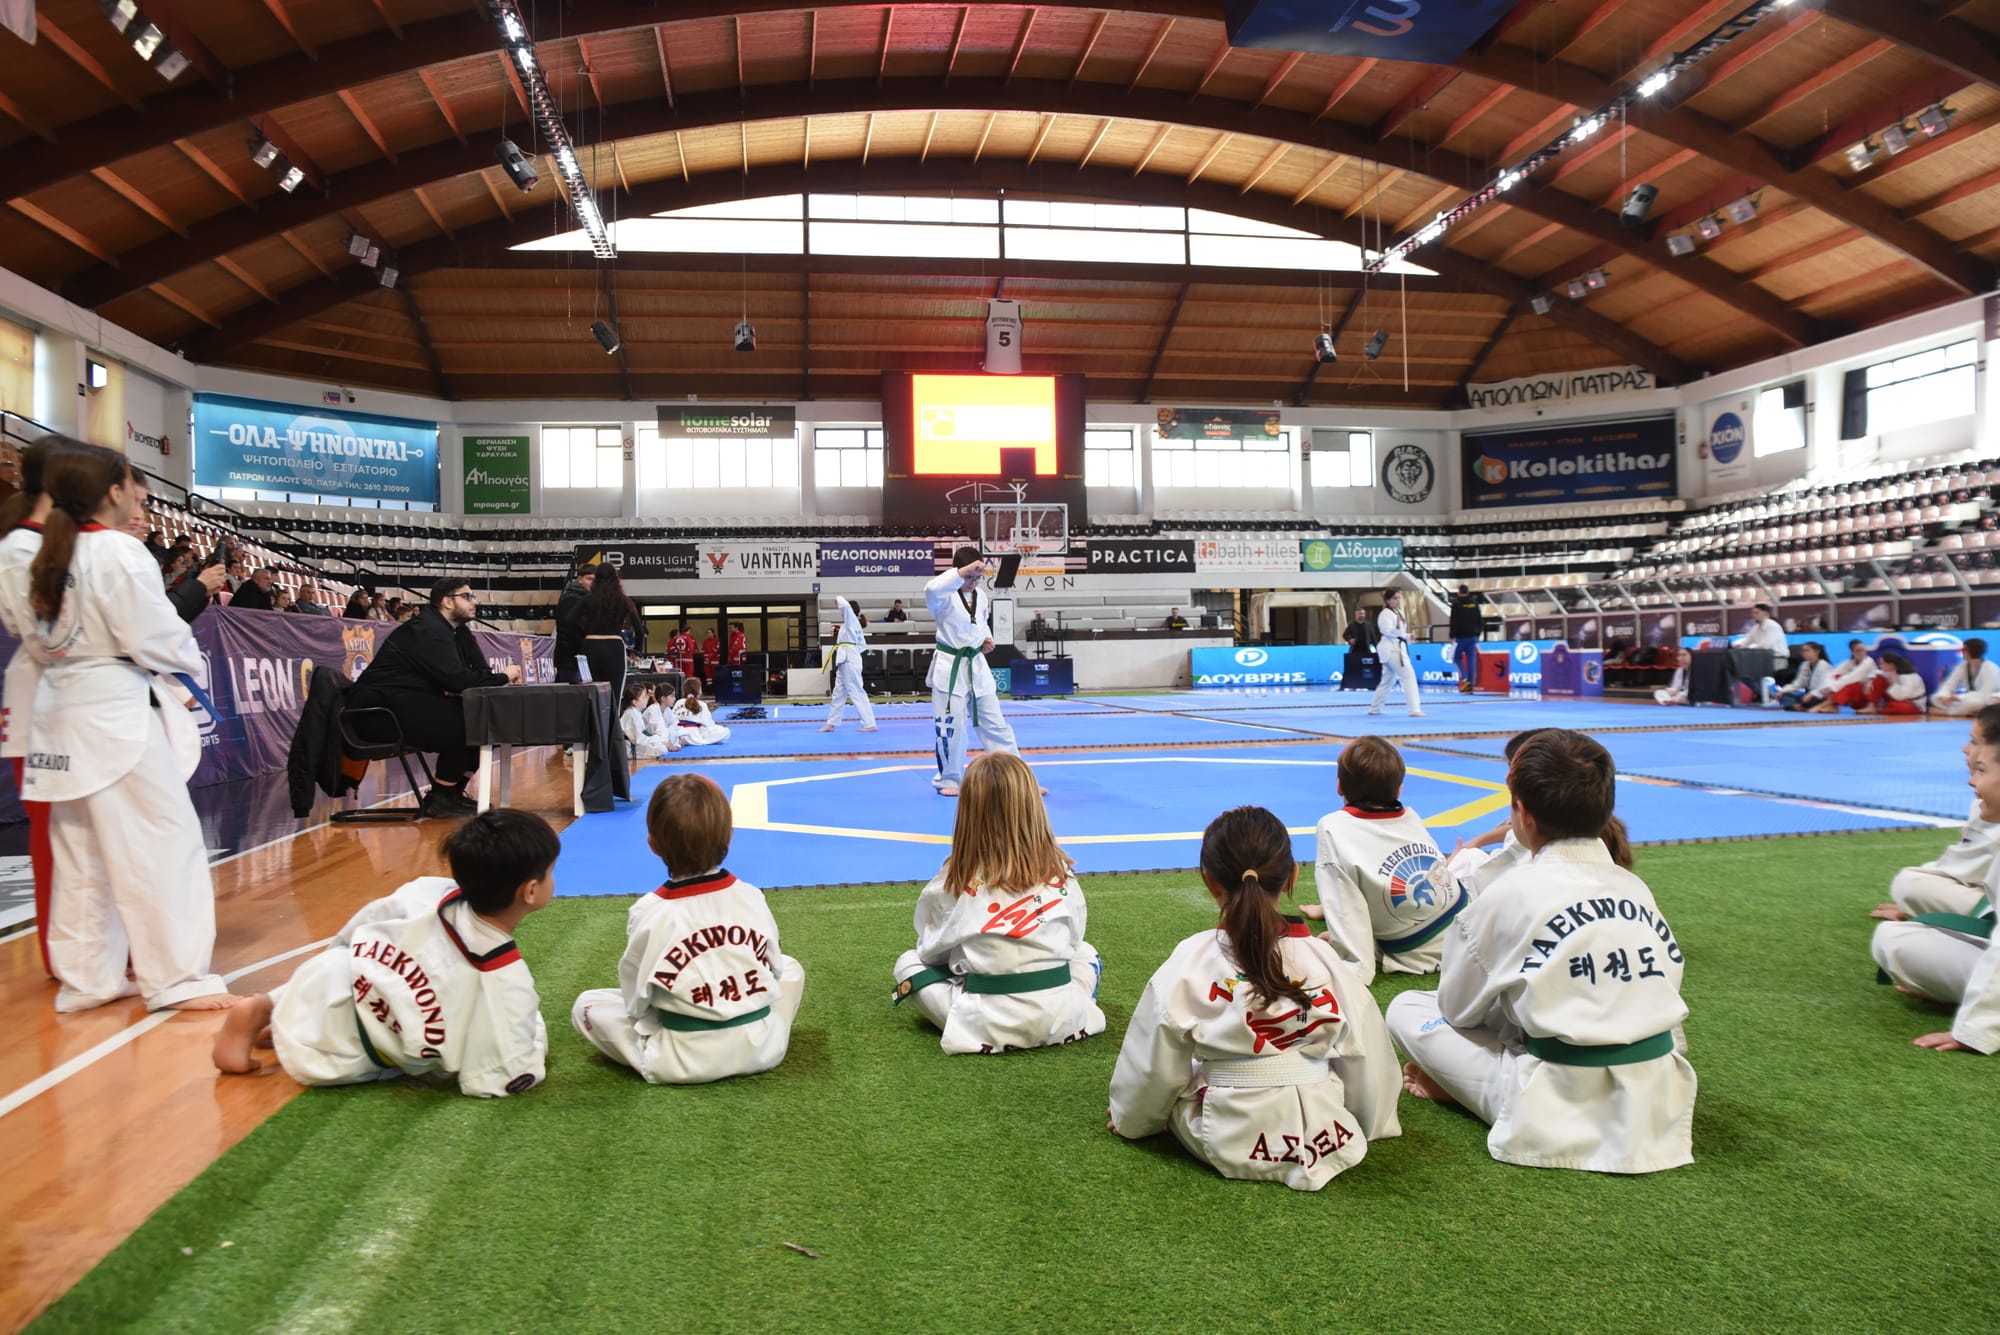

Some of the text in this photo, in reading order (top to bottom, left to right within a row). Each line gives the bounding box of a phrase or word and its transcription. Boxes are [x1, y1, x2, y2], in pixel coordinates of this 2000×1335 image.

[998, 331, 1011, 347] 5
[1471, 371, 1651, 407] ΑΠΟΛΛΩΝ ΠΑΤΡΑΣ
[681, 411, 772, 427] homesolar
[243, 454, 397, 477] ΨΗΤΟΠΩΛΕΙΟ ΕΣΤΙΑΤΟΡΙΟ
[1510, 452, 1671, 479] Kolokithas
[229, 472, 264, 481] ΠΑΤΡΩΝ
[630, 556, 694, 565] BARISLIGHT
[1092, 550, 1188, 563] PRACTICA
[1333, 542, 1399, 563] Δίδυμοι
[740, 553, 812, 569] VANTANA
[229, 657, 297, 714] LEON
[1198, 672, 1306, 684] ΔΟΥΒΡΗΣ
[1378, 843, 1438, 877] TAEKWOND
